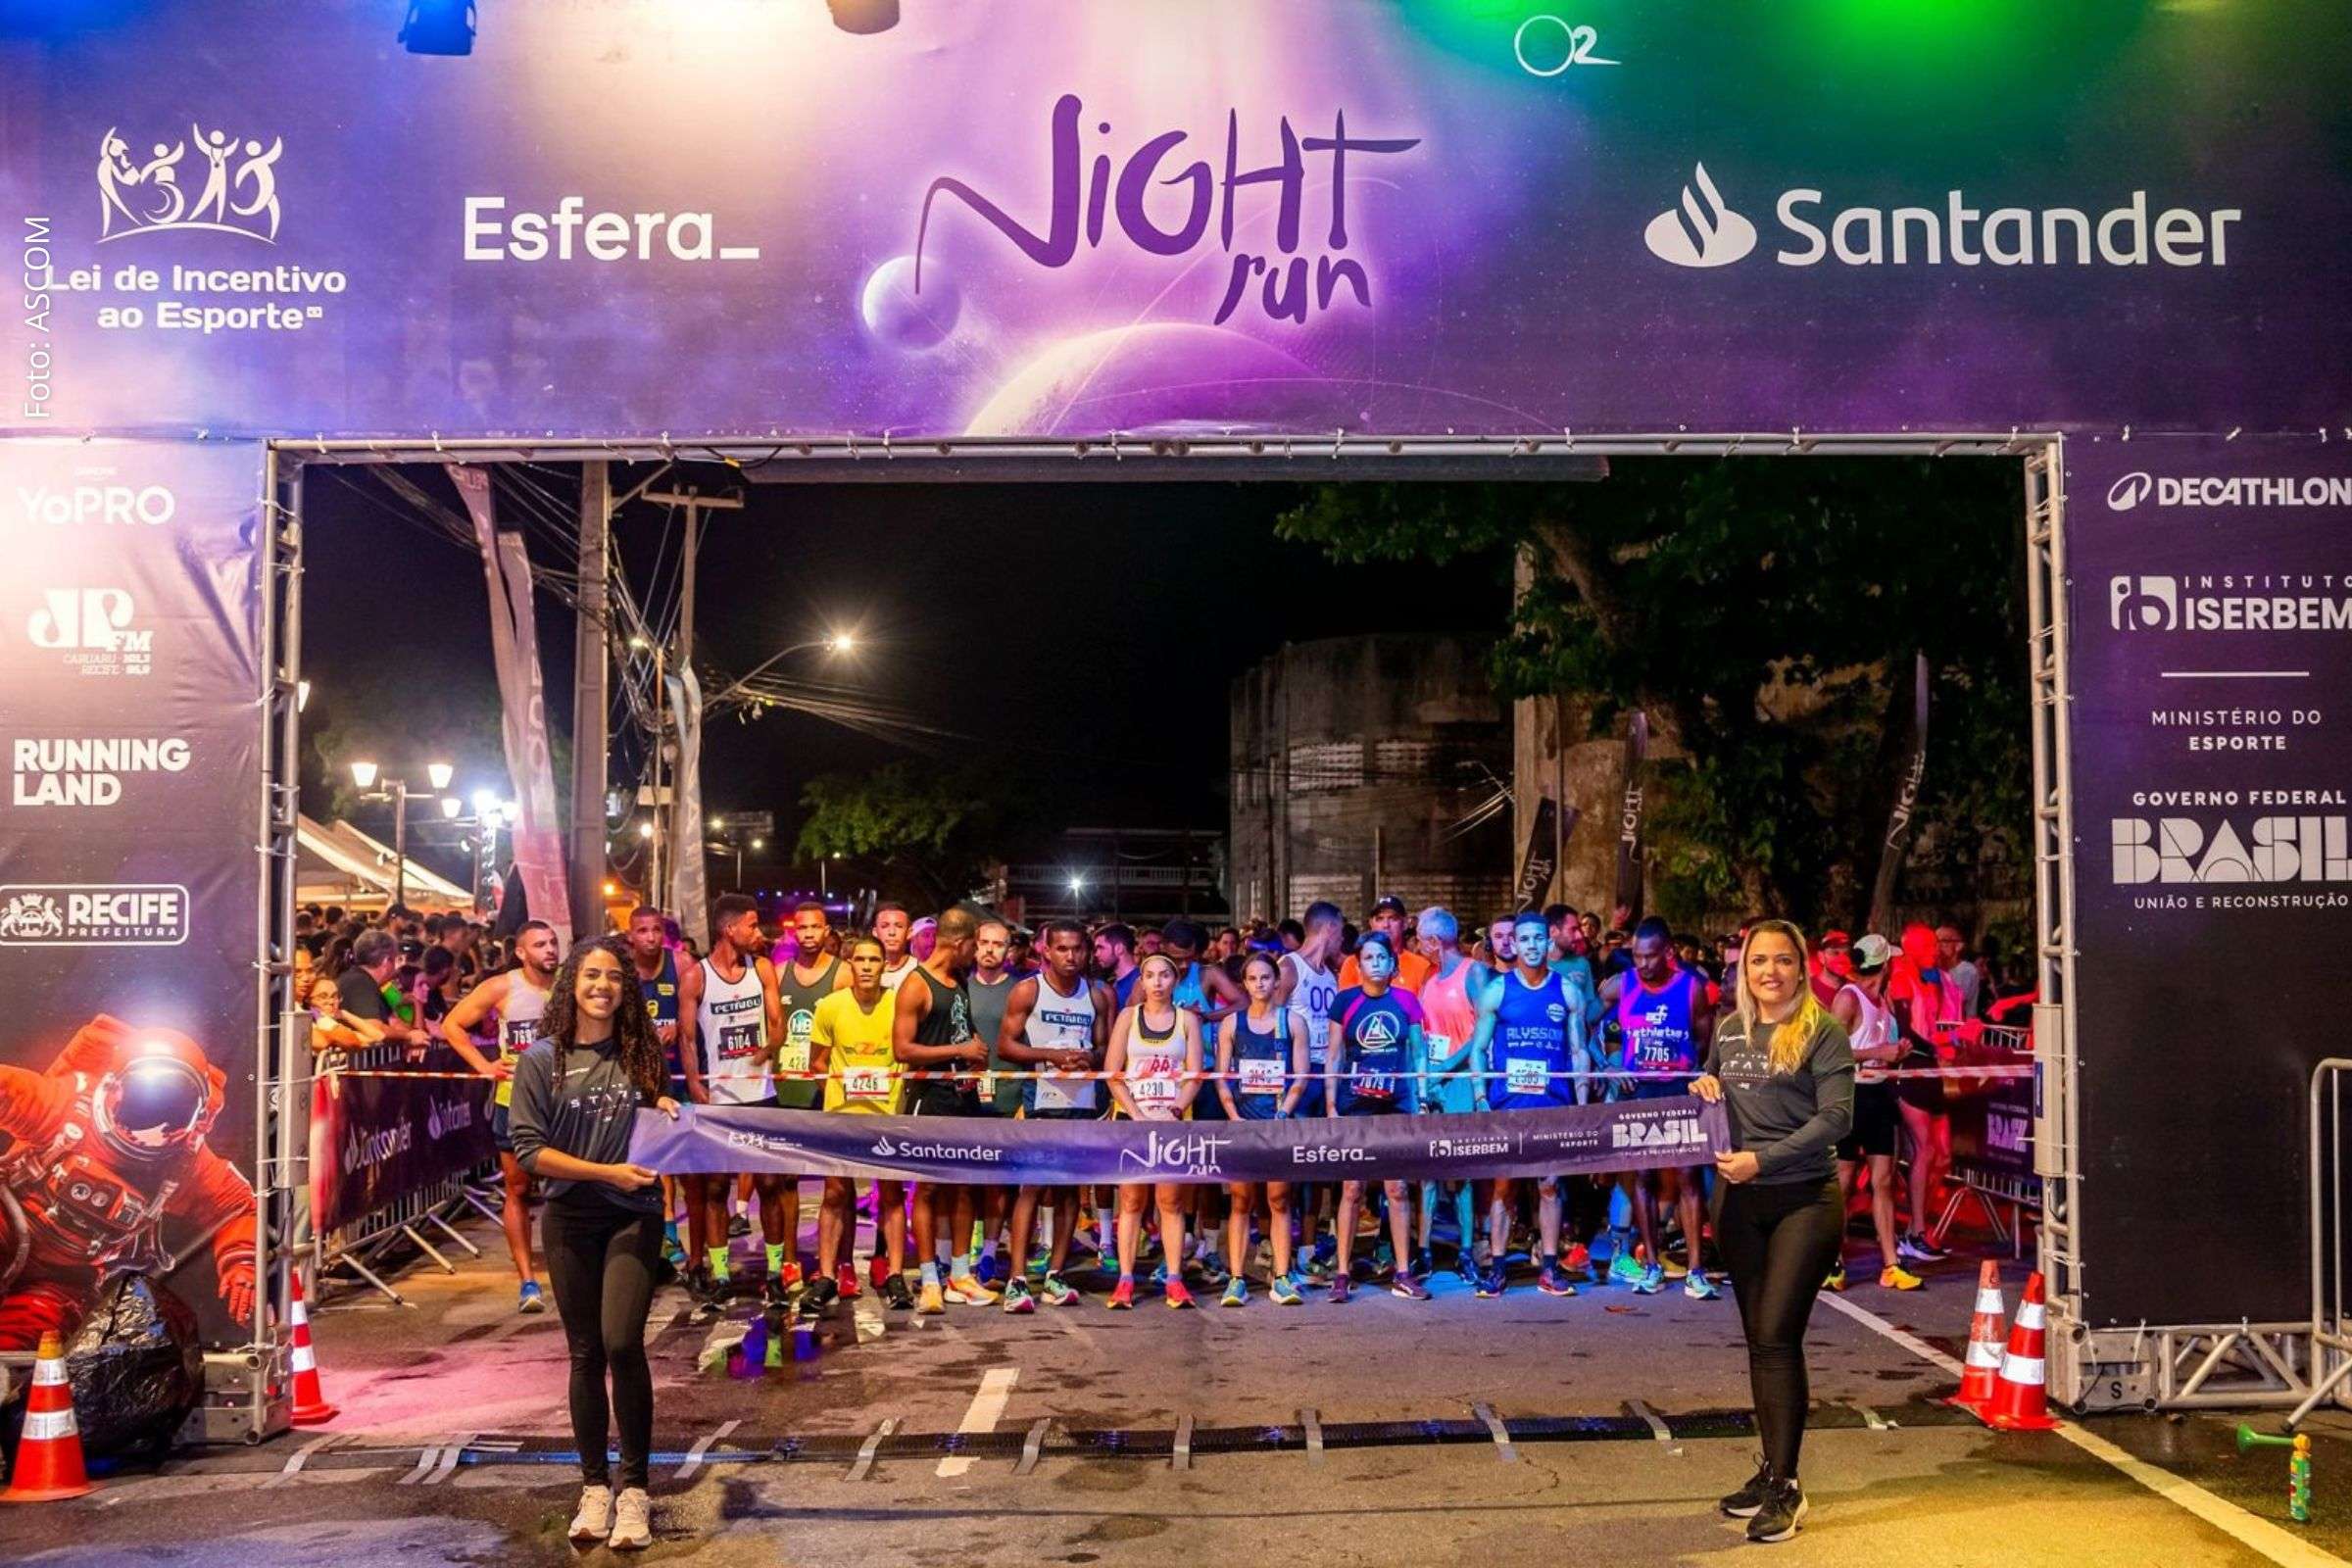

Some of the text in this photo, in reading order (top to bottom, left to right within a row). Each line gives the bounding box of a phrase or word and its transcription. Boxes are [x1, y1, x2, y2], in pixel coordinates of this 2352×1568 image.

[463, 196, 760, 262] Esfera_
[1775, 188, 2242, 267] Santander
[47, 264, 347, 292] Lei de Incentivo
[1213, 252, 1373, 326] run
[97, 302, 305, 335] ao Esporte
[2158, 477, 2352, 506] DECATHLON
[2184, 596, 2352, 630] ISERBEM
[2152, 707, 2322, 726] MINISTÉRIO DO
[14, 738, 191, 772] RUNNING
[2188, 736, 2286, 751] ESPORTE
[13, 772, 122, 807] LAND
[2132, 790, 2347, 807] GOVERNO FEDERAL
[2111, 815, 2352, 884] BRASIL
[68, 893, 178, 926] RECIFE
[2133, 892, 2349, 909] UNIÃO E RECONSTRUÇÃO
[68, 927, 178, 938] PREFEITURA
[1643, 1046, 1670, 1062] 7705
[1612, 1118, 1708, 1149] BRASIL
[899, 1141, 1003, 1162] Santander
[1452, 1143, 1509, 1157] ISERBEM
[2110, 1380, 2123, 1399] S
